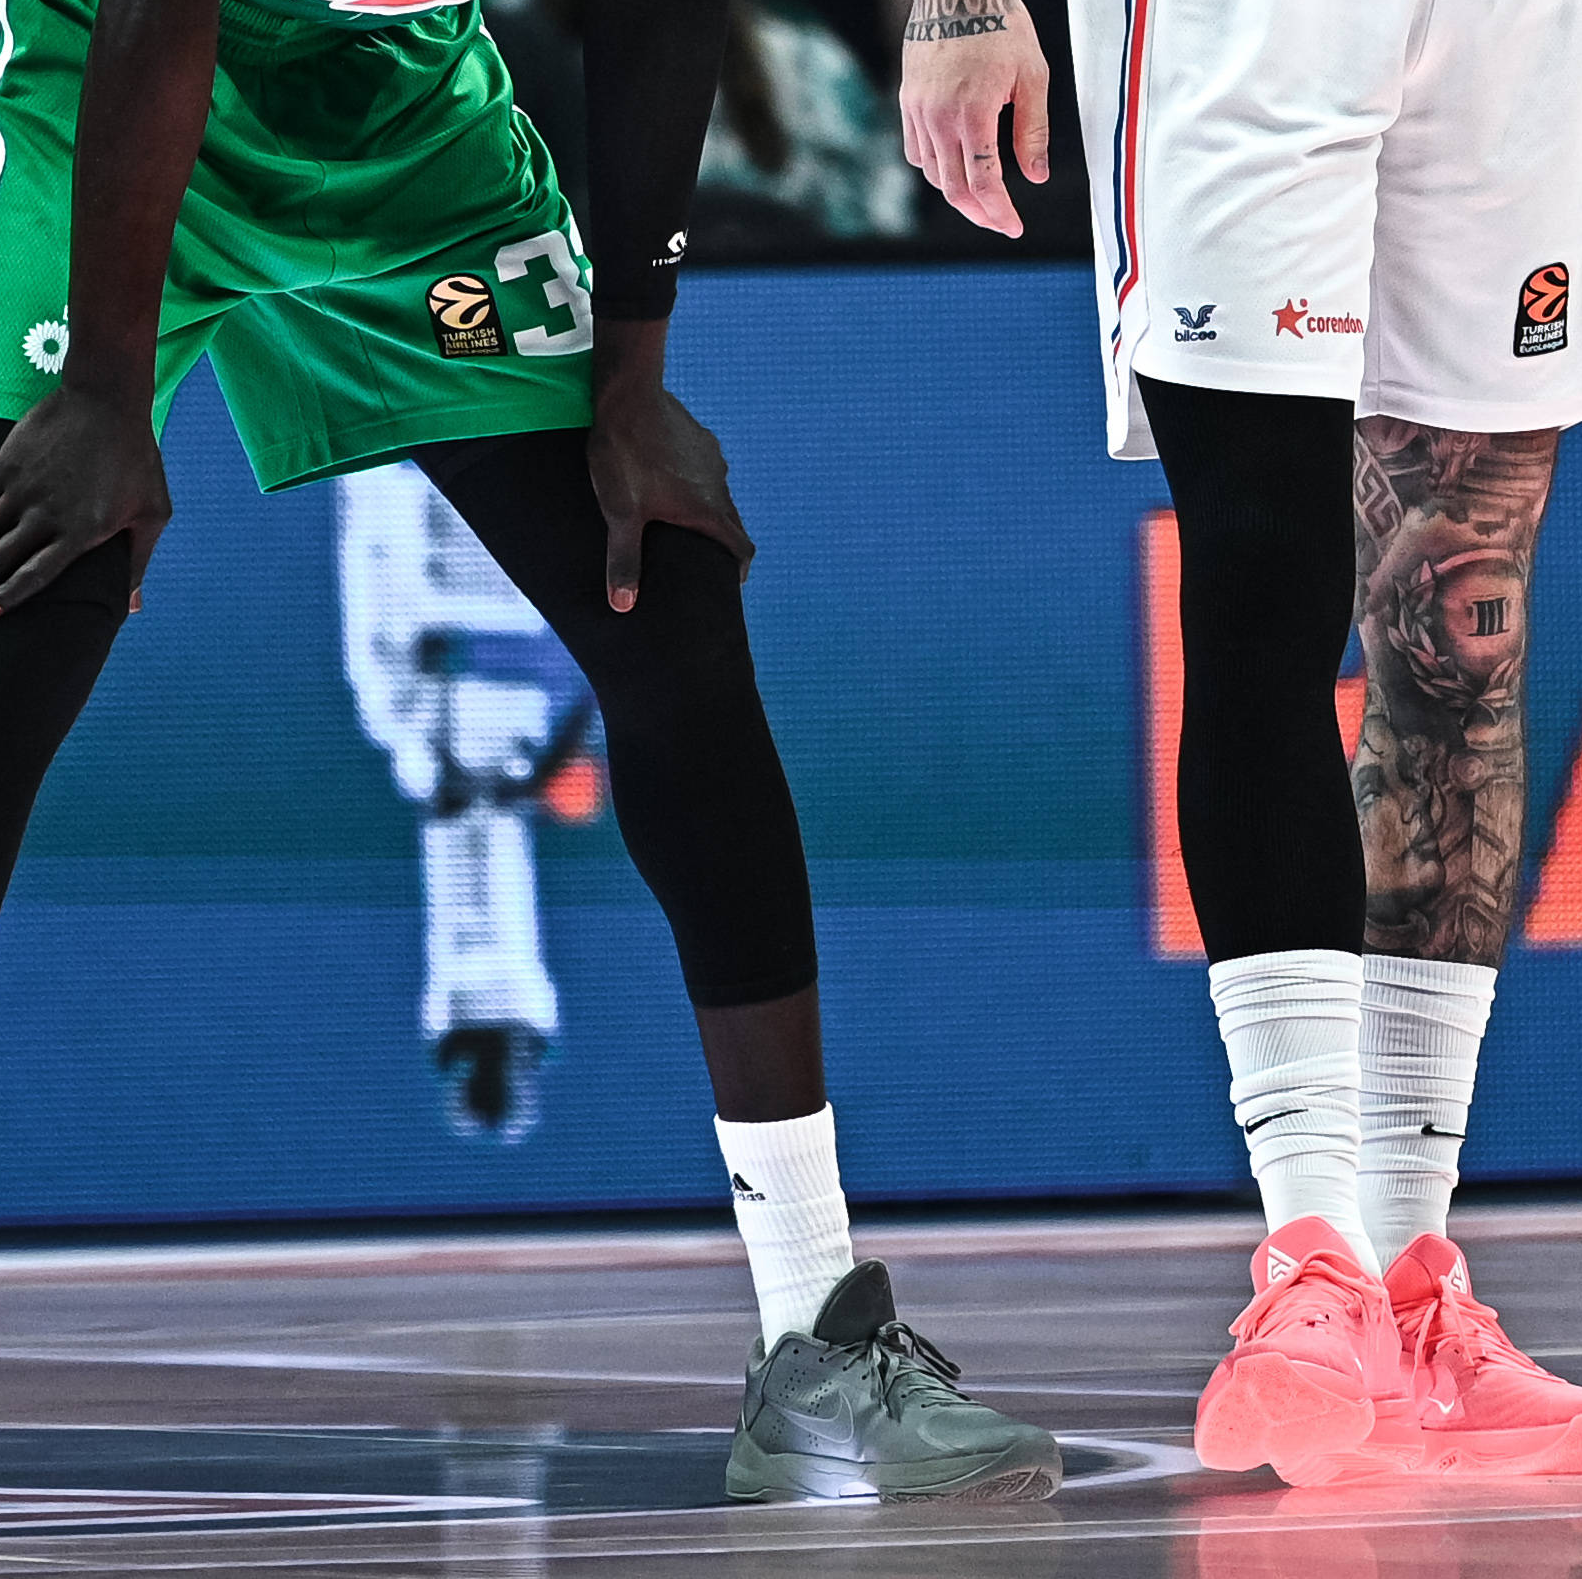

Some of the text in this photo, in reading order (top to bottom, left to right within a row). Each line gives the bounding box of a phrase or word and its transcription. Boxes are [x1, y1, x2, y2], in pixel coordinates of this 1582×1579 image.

[1307, 312, 1365, 334] corendon
[1521, 319, 1565, 336] TURKISH
[442, 327, 496, 341] TURKISH
[1520, 328, 1564, 345] AIRLINES
